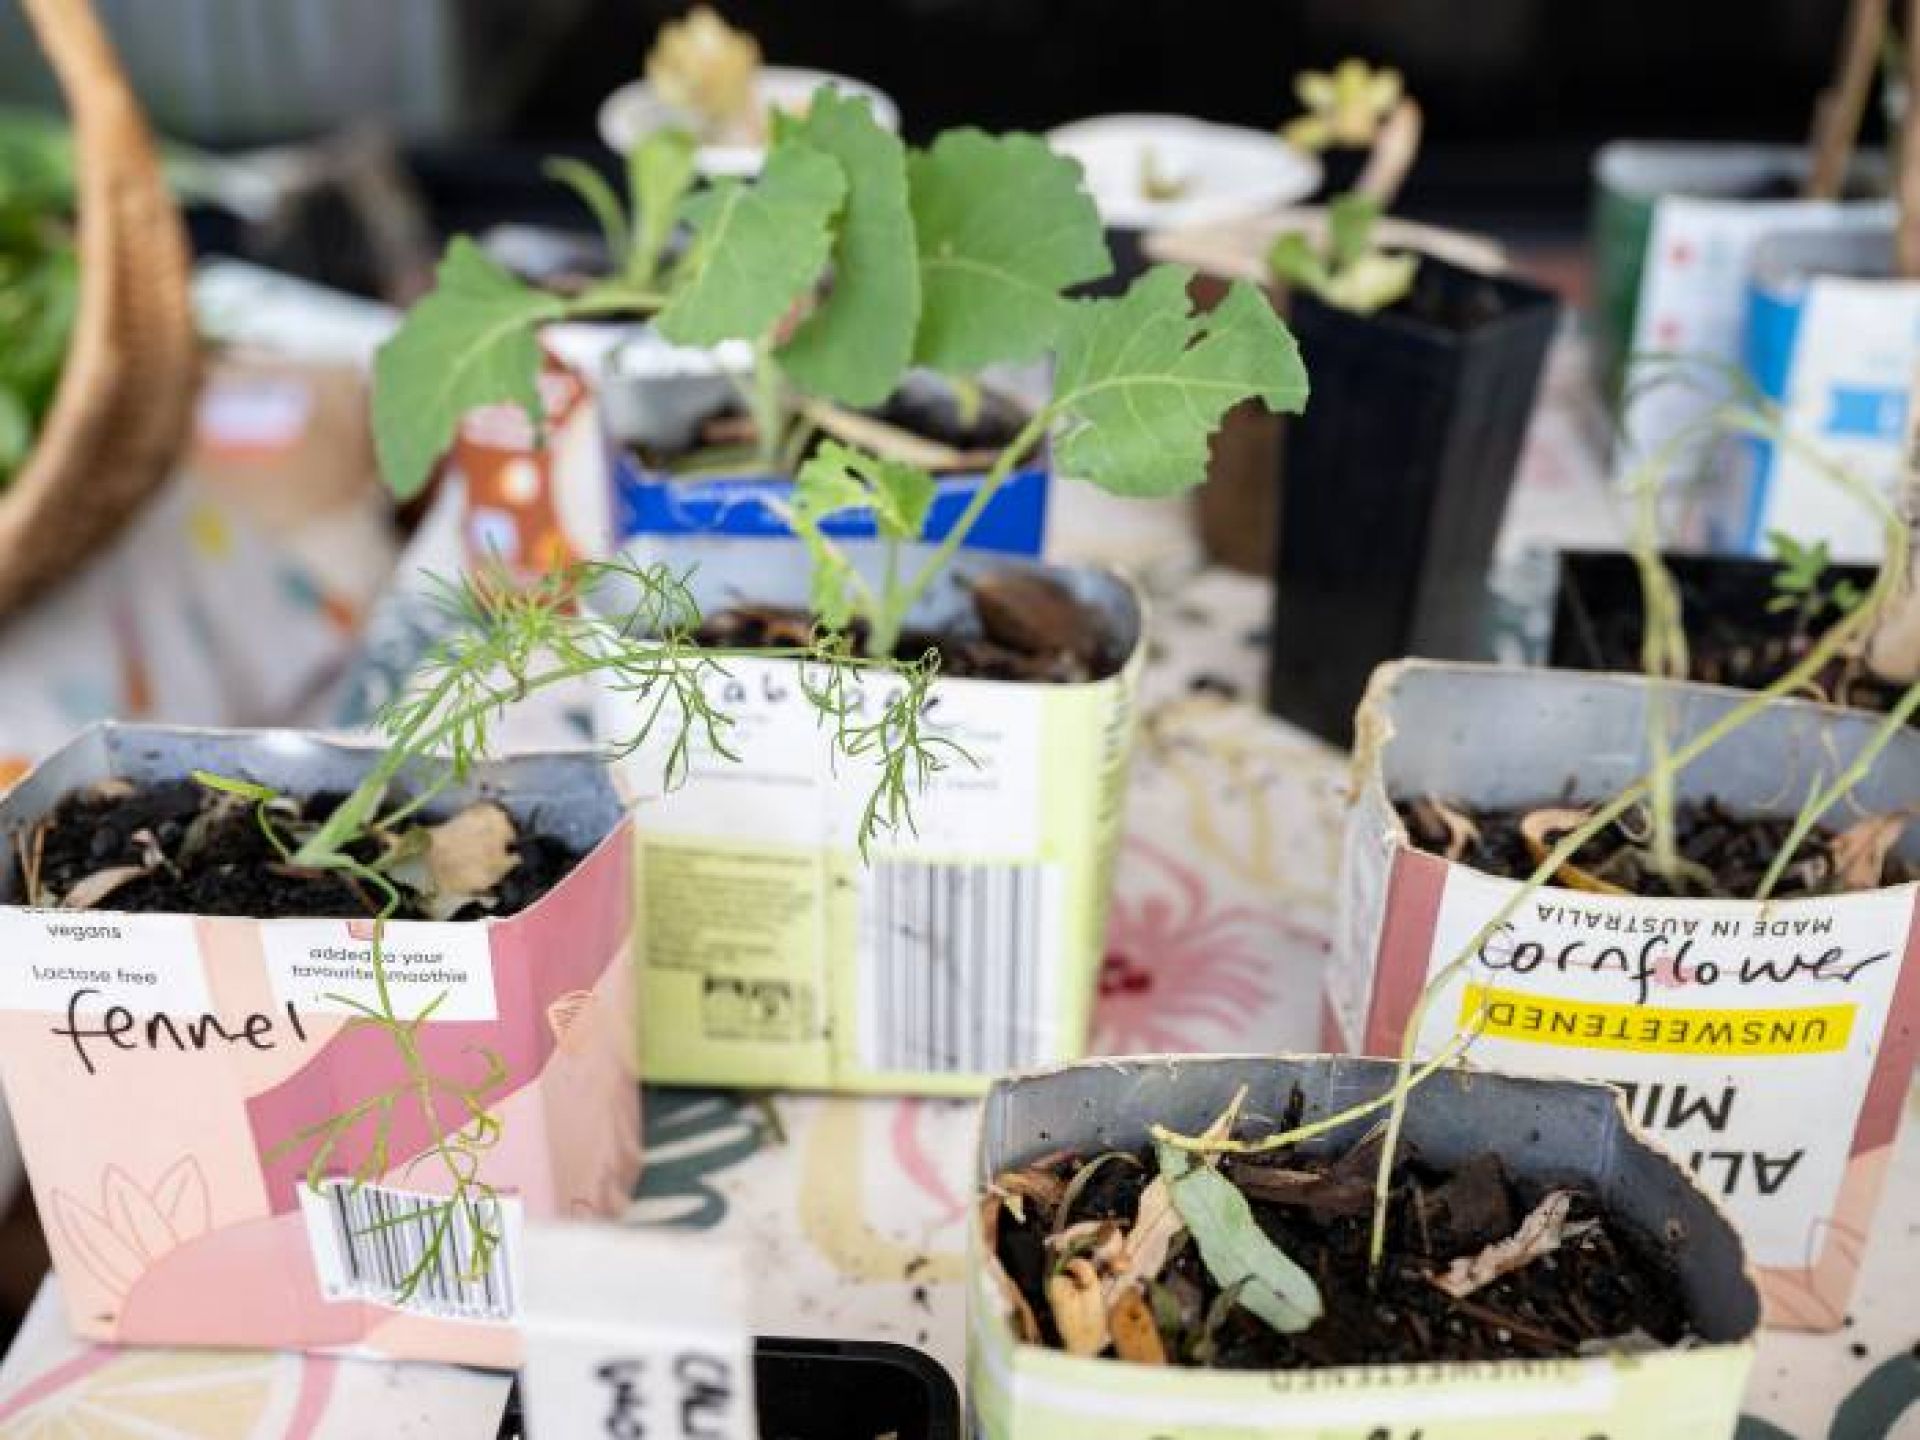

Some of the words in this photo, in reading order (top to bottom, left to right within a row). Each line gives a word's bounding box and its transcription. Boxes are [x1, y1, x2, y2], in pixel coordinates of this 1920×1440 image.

[1537, 903, 1699, 936] AUSTRALIA
[1711, 920, 1741, 937] IN
[1753, 914, 1833, 936] MADE
[46, 923, 122, 942] vegans
[308, 945, 372, 962] added
[402, 951, 444, 967] your
[1478, 920, 1892, 1007] Cornflower
[31, 964, 111, 983] Lactose
[116, 967, 158, 985] free
[291, 963, 374, 980] favourite
[383, 966, 468, 983] moothie
[50, 988, 307, 1076] fennel
[1487, 1002, 1828, 1047] UNSWEETENED
[1605, 1082, 1737, 1131] MIL
